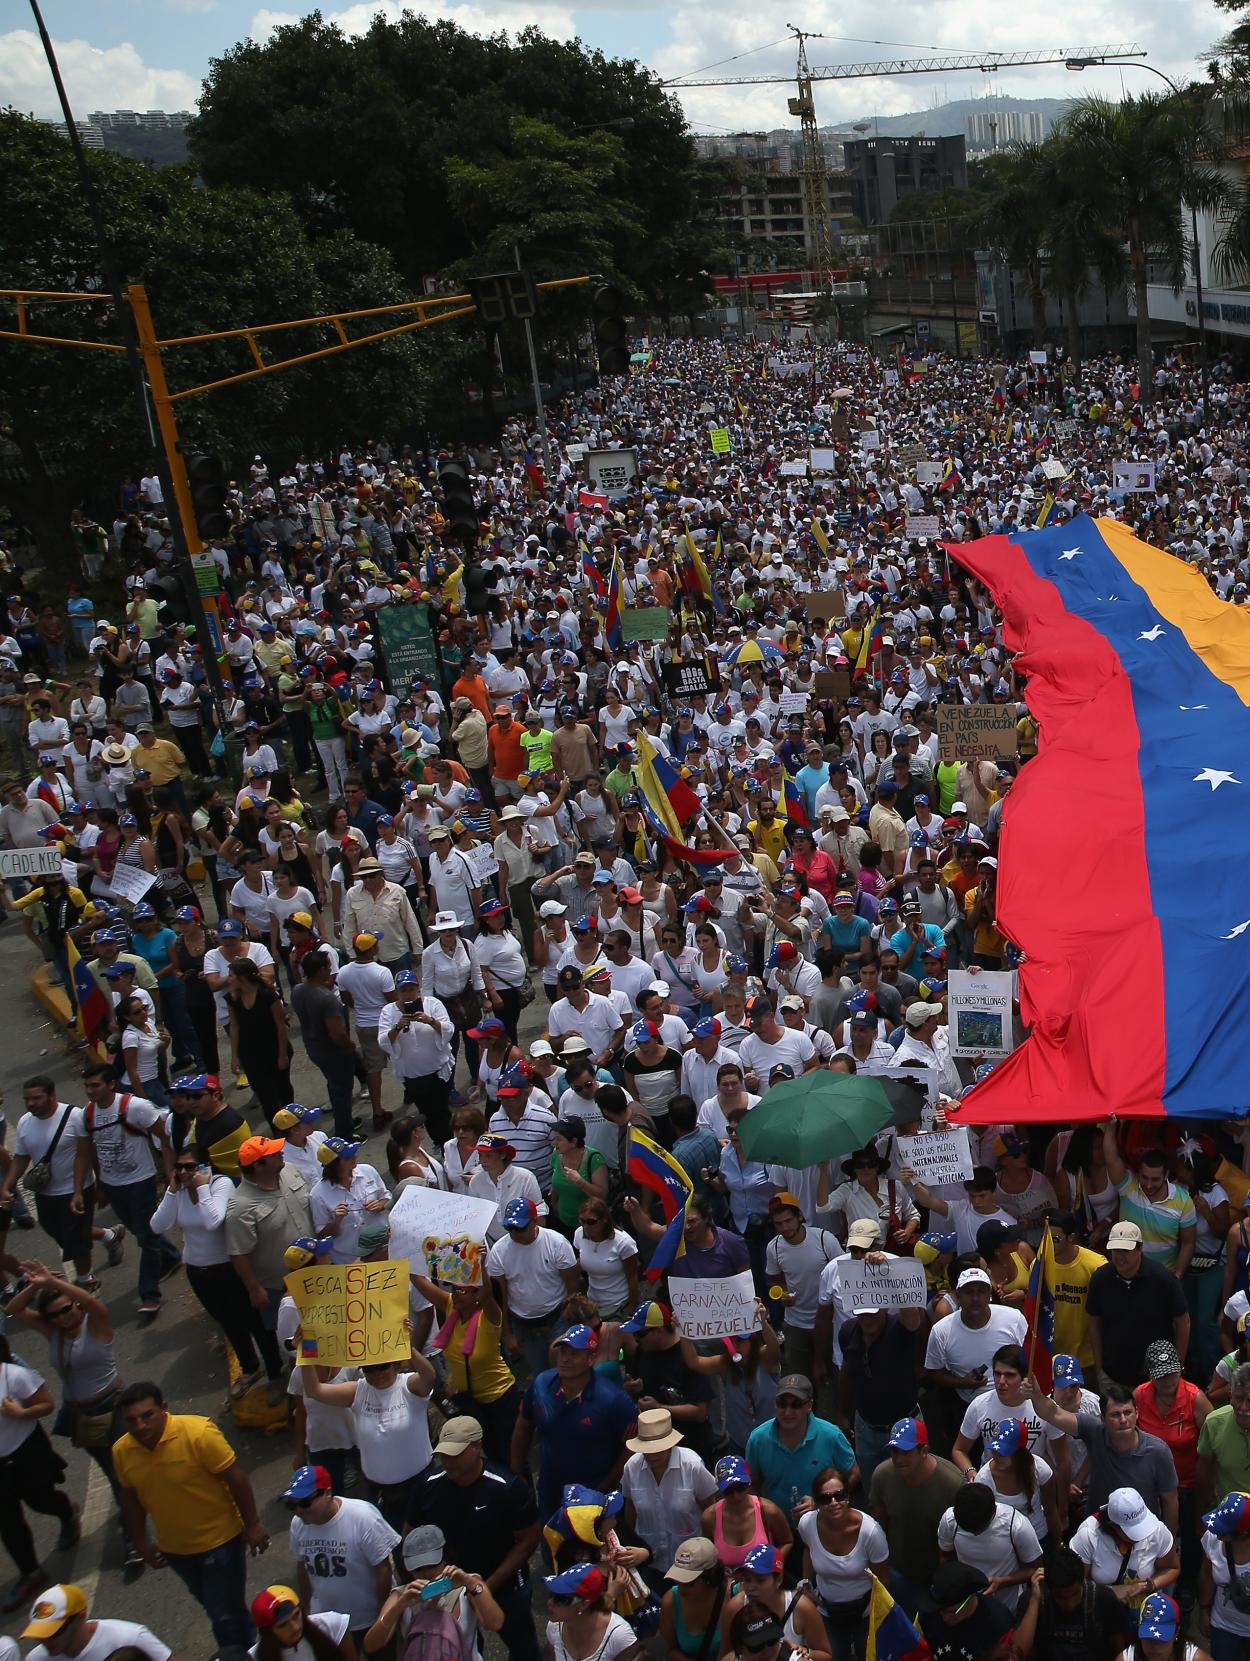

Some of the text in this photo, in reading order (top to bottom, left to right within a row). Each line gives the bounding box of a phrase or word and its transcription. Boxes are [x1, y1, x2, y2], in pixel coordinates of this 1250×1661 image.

[404, 667, 421, 677] LAS
[683, 677, 706, 686] BASTA
[942, 707, 1009, 720] VENEZUELA
[940, 723, 954, 733] EN
[939, 731, 979, 744] EL PAÍS
[938, 747, 951, 759] TE
[913, 1136, 924, 1145] NO
[938, 1172, 966, 1184] NOTICIAS
[865, 1260, 891, 1277] NO
[303, 1267, 399, 1296] ESCASEZ
[694, 1282, 731, 1292] ESTE
[844, 1275, 924, 1289] A LA INTIMIDACIÓN
[673, 1293, 752, 1307] CARNAVAL
[852, 1292, 923, 1305] DE LOS MEDIOS
[681, 1308, 742, 1319] ES PARA
[678, 1316, 762, 1338] VENEZUELA
[299, 1539, 339, 1549] LIBERTAD
